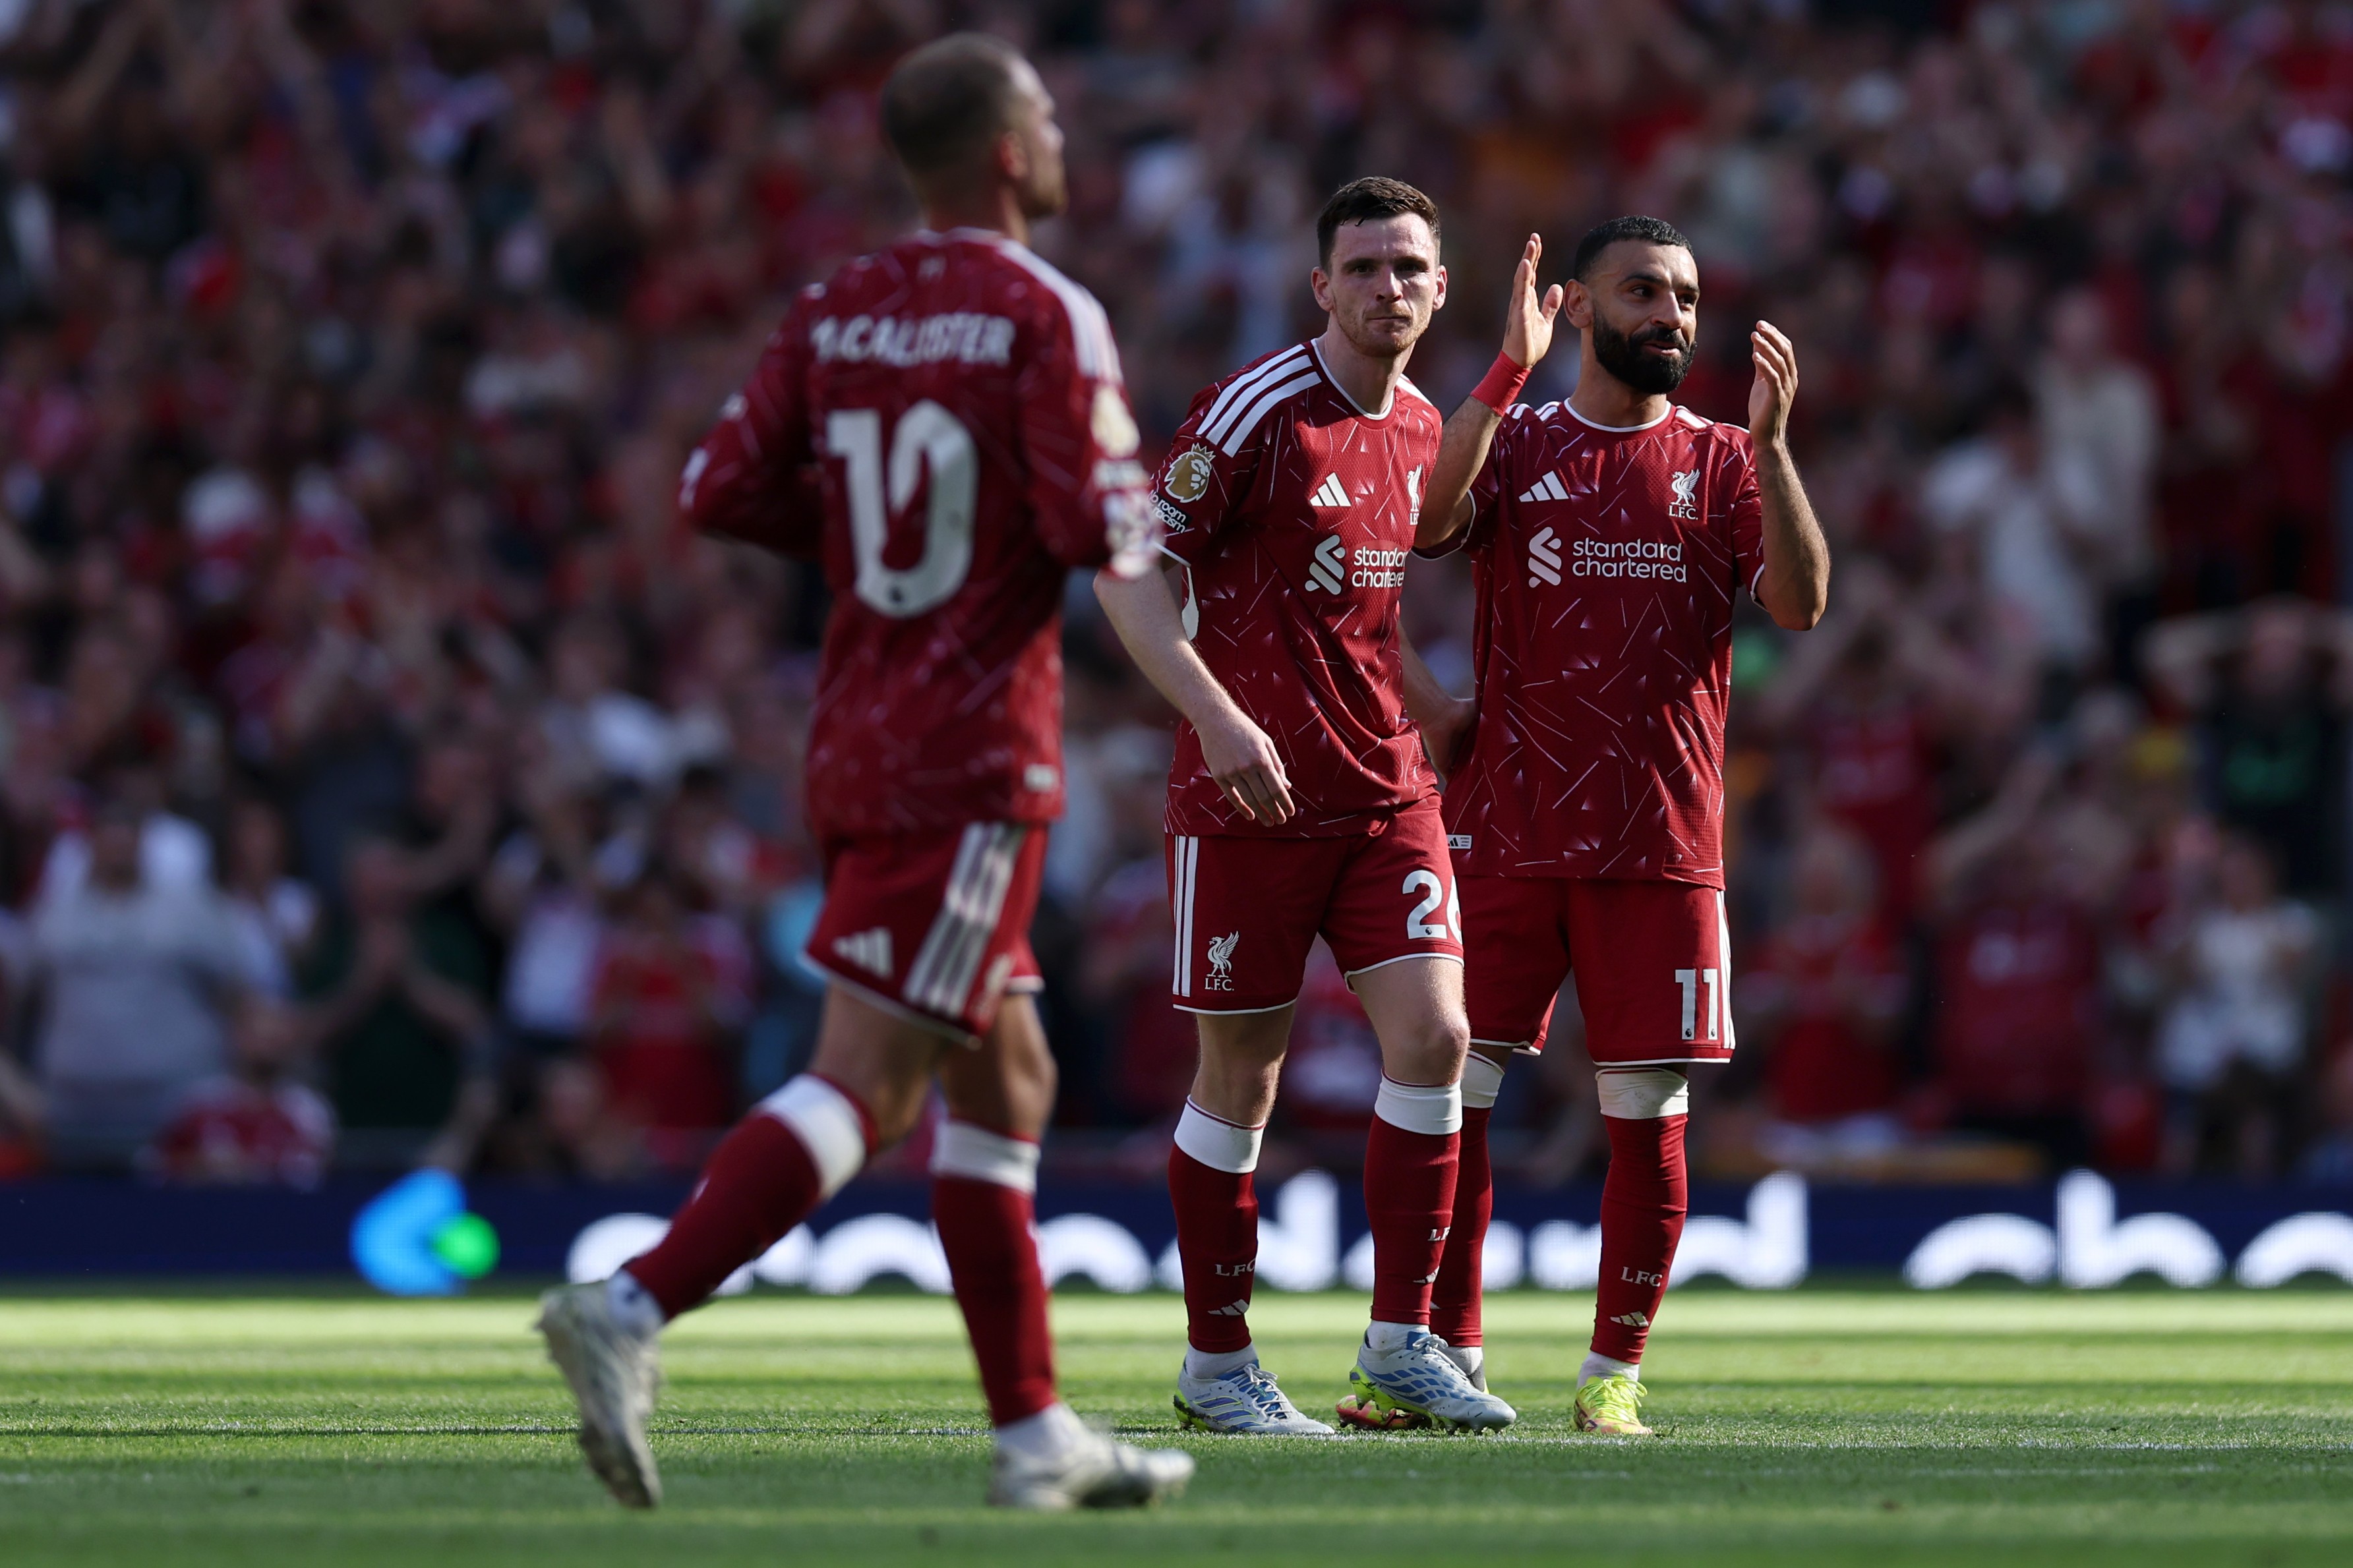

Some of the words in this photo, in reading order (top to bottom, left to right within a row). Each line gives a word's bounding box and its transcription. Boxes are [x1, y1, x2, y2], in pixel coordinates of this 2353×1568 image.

[828, 398, 978, 618] 10
[1158, 499, 1187, 523] room
[1669, 505, 1698, 520] L.F.C.
[1572, 537, 1683, 562] standard
[1572, 556, 1687, 583] chartered
[1205, 977, 1235, 991] L.F.C.
[1675, 968, 1718, 1040] 11
[1621, 1266, 1663, 1287] LFC
